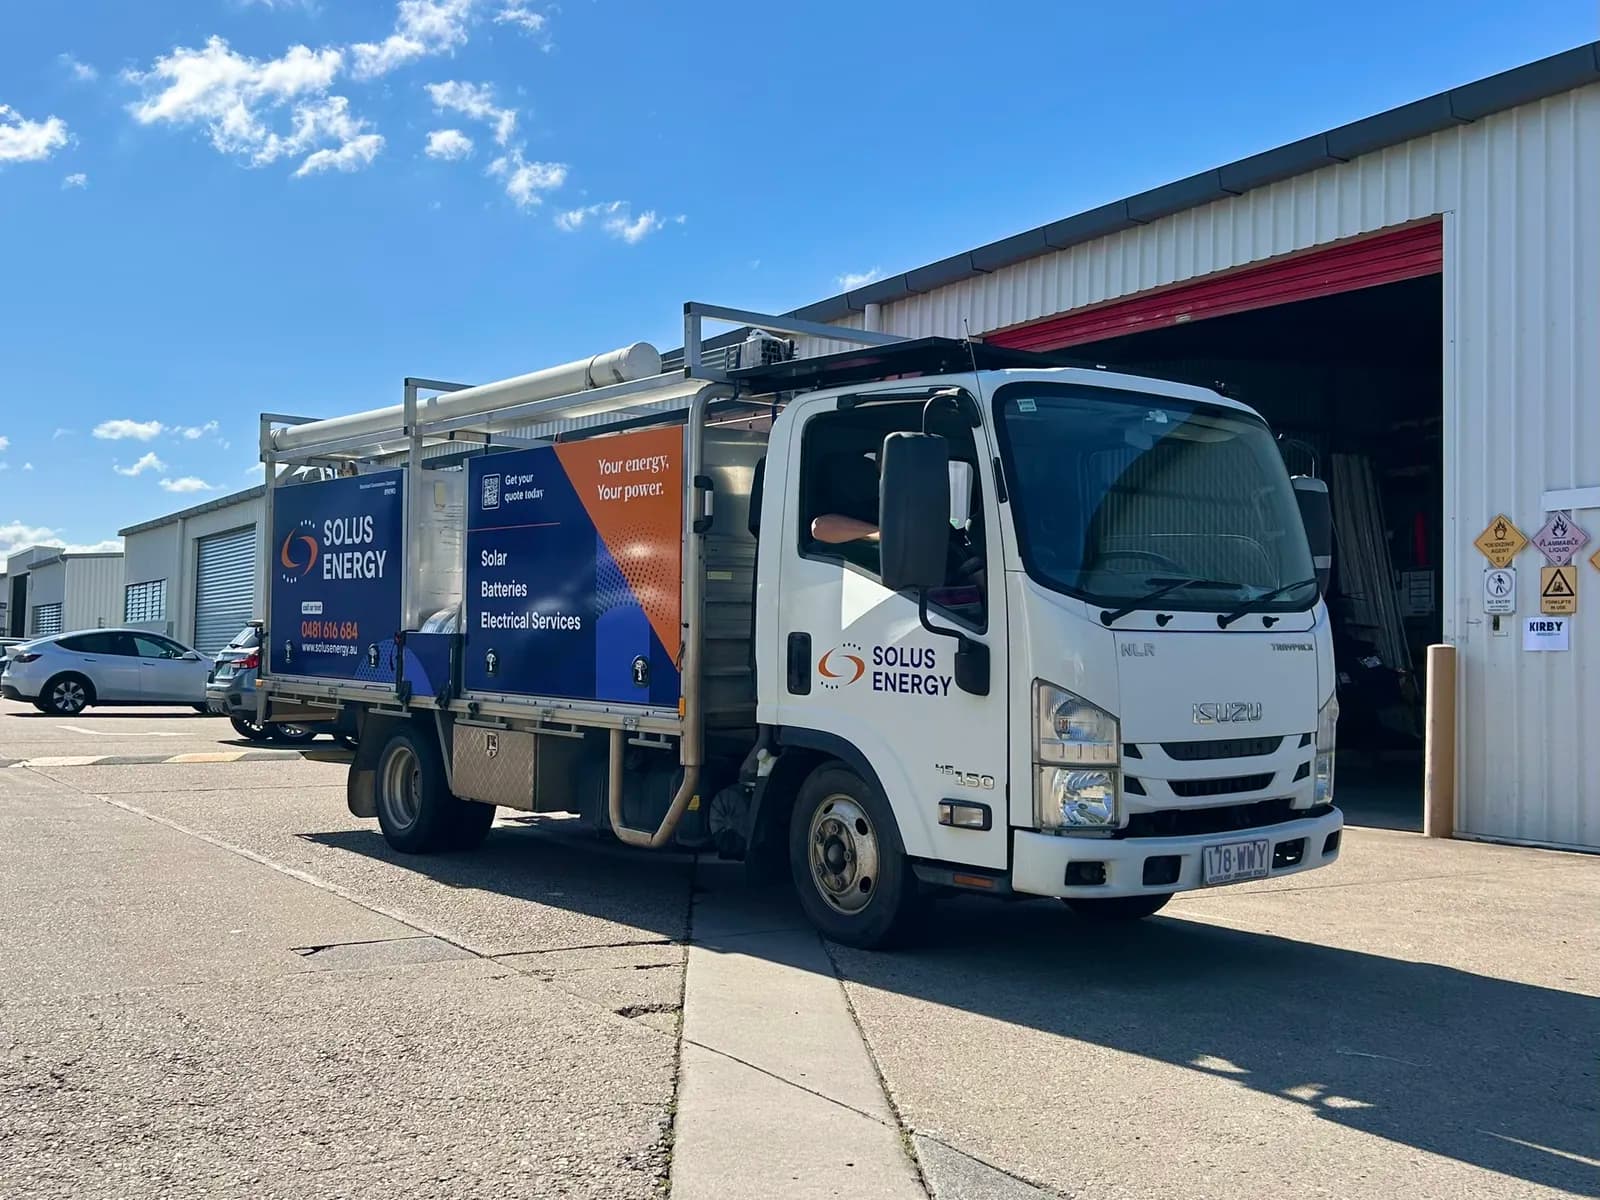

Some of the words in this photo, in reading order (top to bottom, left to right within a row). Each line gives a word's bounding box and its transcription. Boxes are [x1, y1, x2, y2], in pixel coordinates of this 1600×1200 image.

[599, 459, 623, 475] Your
[505, 474, 517, 486] Get
[518, 473, 533, 485] your
[505, 492, 523, 503] quote
[525, 488, 544, 499] today
[597, 484, 622, 500] Your
[624, 481, 664, 502] power.
[323, 515, 374, 546] SOLUS
[323, 550, 387, 580] ENERGY
[481, 550, 507, 567] Solar
[481, 580, 528, 598] Batteries
[302, 620, 321, 638] 0481
[323, 621, 339, 639] 616
[340, 621, 358, 640] 684
[481, 611, 530, 629] Electrical
[532, 612, 581, 630] Services
[1529, 621, 1563, 632] KIRBY
[302, 641, 358, 656] www.solusenergy.au
[873, 646, 936, 669] SOLUS
[1121, 643, 1155, 657] NLR
[873, 671, 952, 696] ENERGY
[1192, 702, 1263, 724] ISUZU
[954, 770, 995, 790] 150
